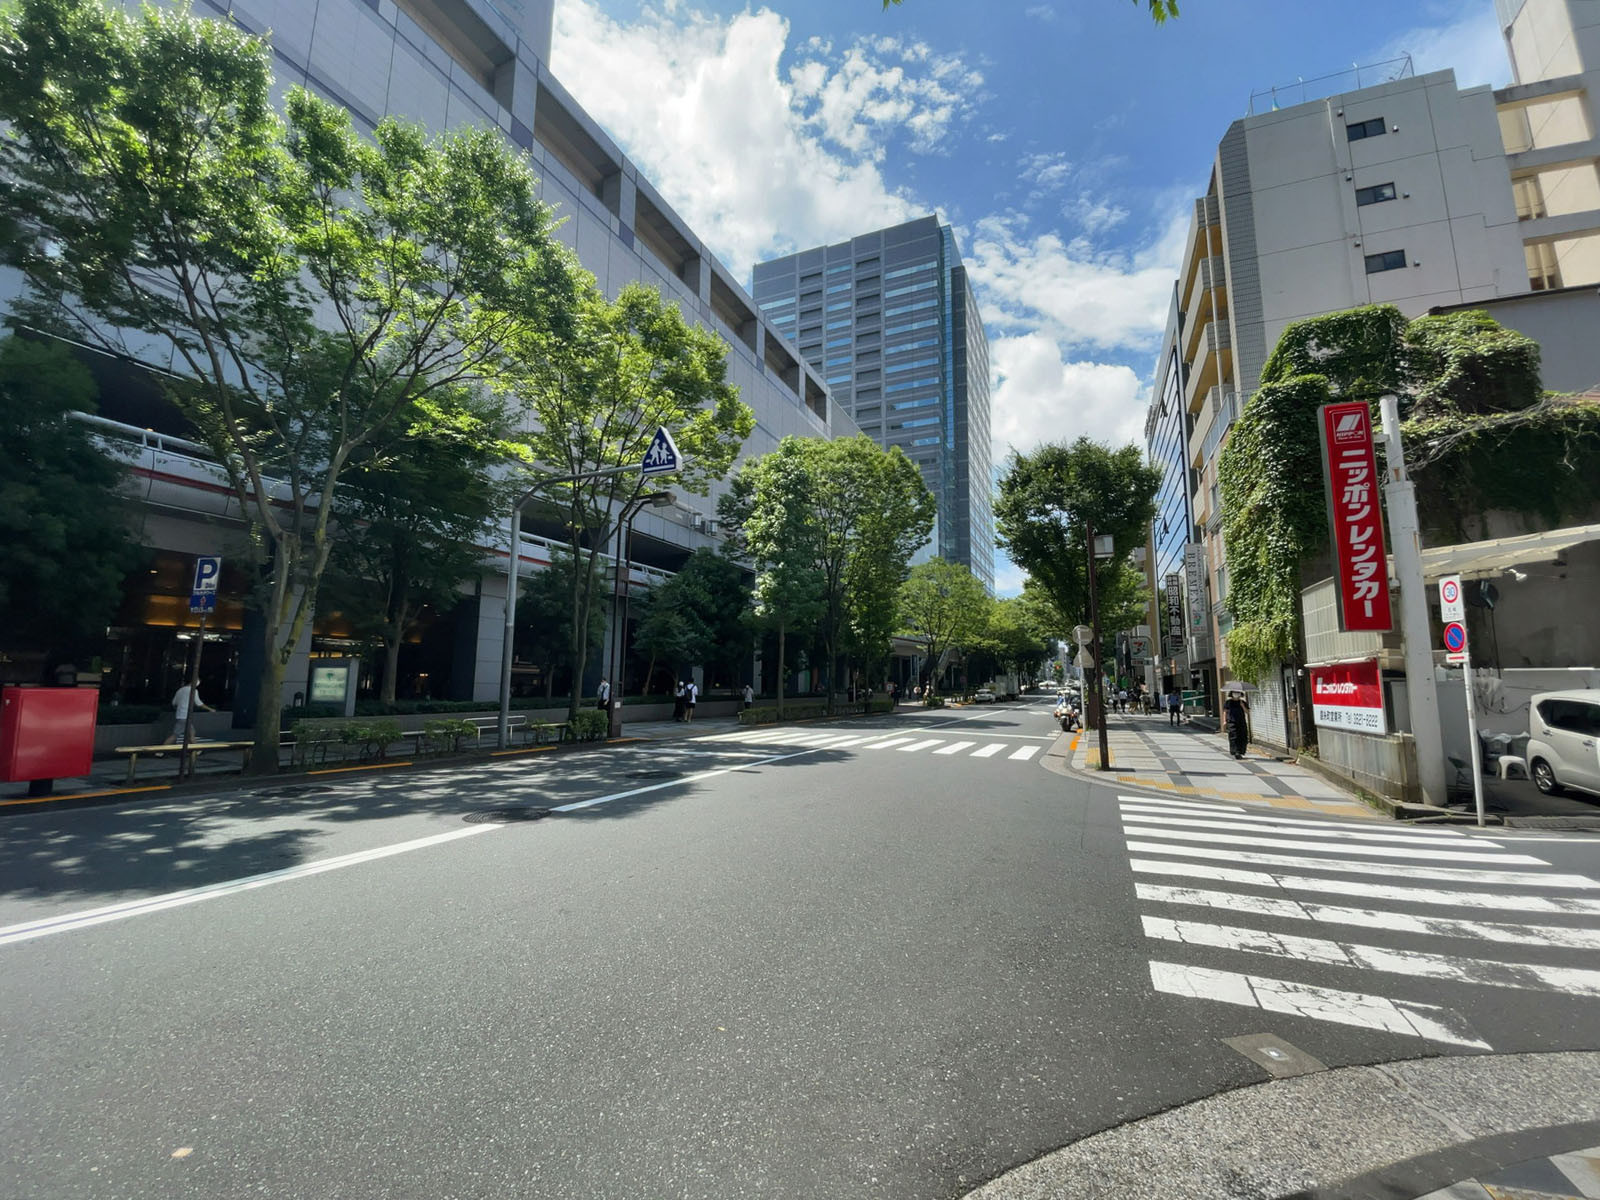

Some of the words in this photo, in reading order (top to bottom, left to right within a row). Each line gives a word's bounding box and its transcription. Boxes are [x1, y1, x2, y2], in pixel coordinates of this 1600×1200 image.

[1339, 450, 1379, 618] ニッポンレンタカー
[196, 558, 218, 588] P
[1187, 553, 1199, 604] BREMEN
[1446, 586, 1456, 598] 30
[1168, 586, 1181, 636] 昭和不動産
